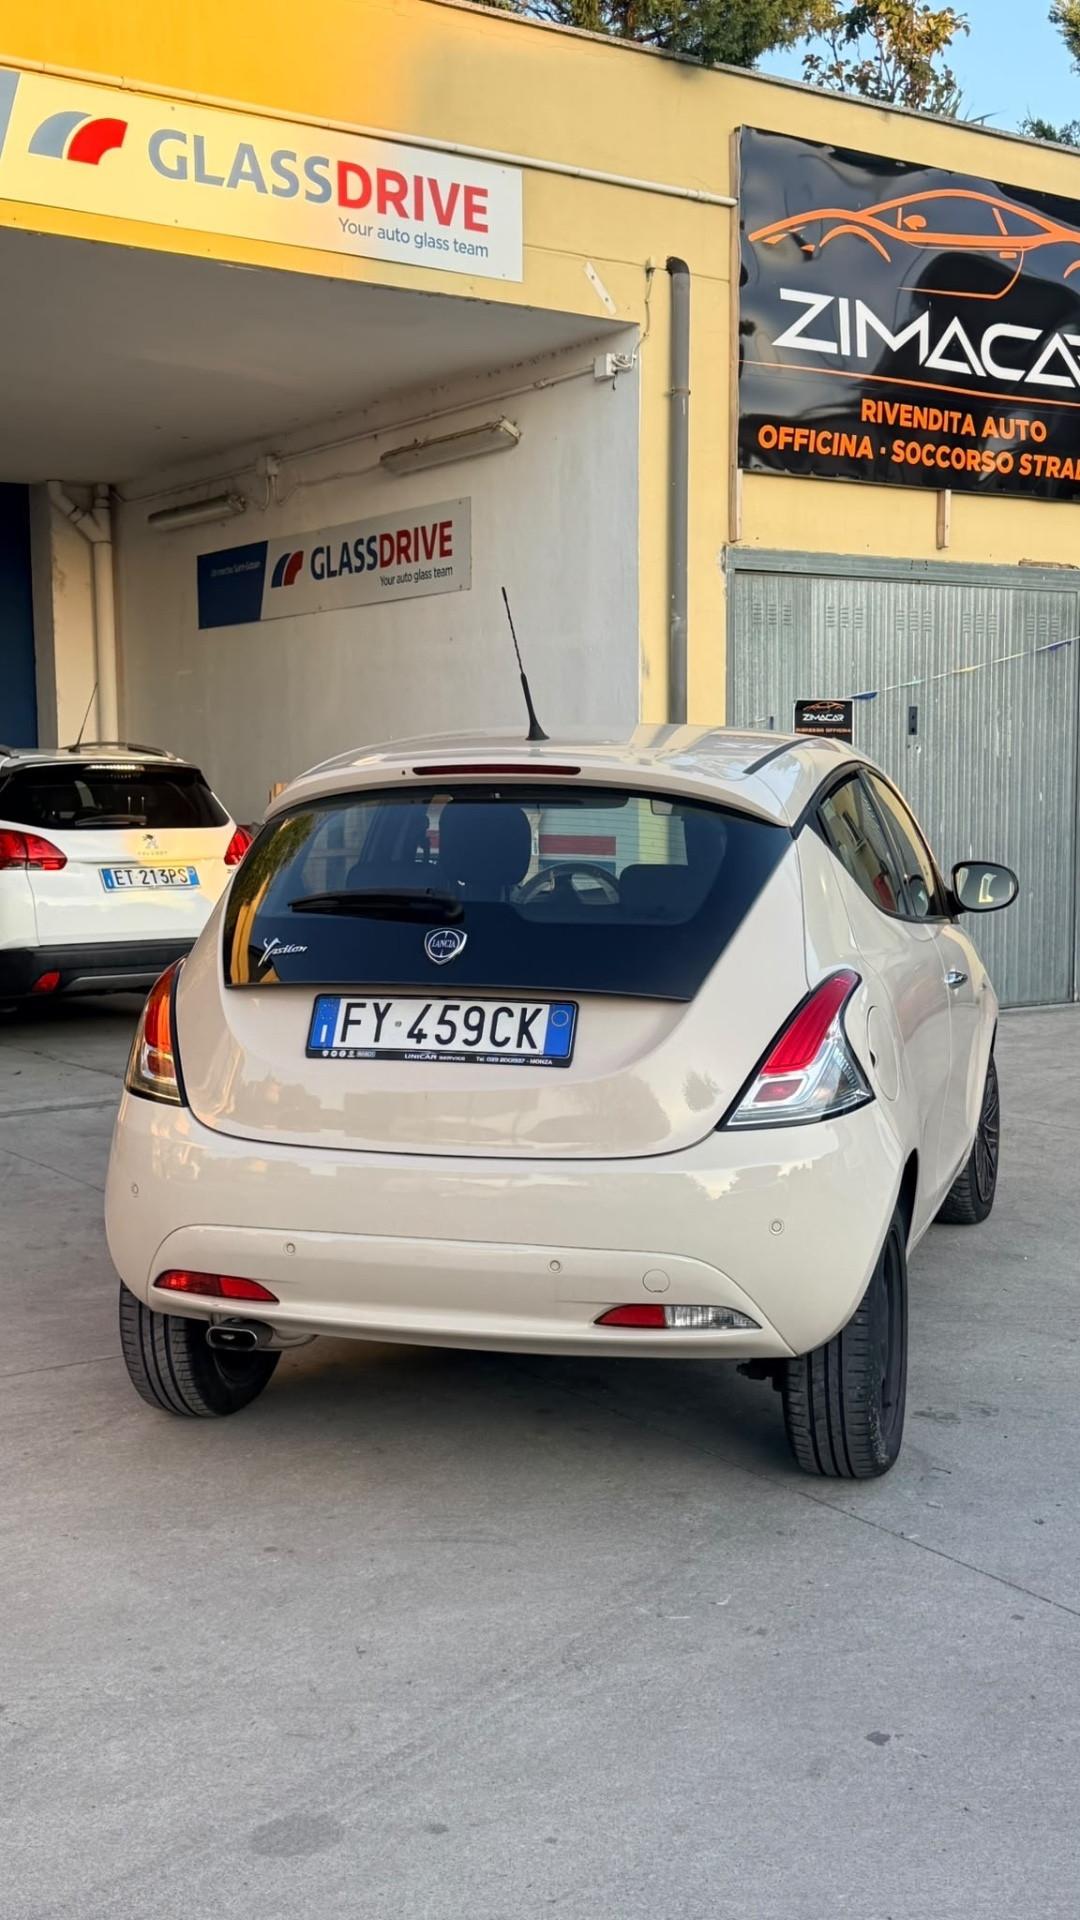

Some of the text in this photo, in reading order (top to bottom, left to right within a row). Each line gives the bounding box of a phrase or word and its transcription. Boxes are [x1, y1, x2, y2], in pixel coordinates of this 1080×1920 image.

[148, 128, 489, 234] GLASSDRIVE
[338, 217, 489, 258] Your auto glass team
[861, 399, 1047, 442] RIVENDITA AUTO
[757, 425, 873, 460] OFFICINA
[891, 440, 1014, 474] SOCCORSO
[310, 520, 453, 581] GLASSDRIVE
[379, 566, 453, 587] Your auto glass team
[802, 713, 845, 721] ZIMACAR
[114, 868, 188, 885] ET 213PS
[258, 937, 308, 967] Ypsilon
[431, 939, 456, 949] LANCIA
[340, 1002, 543, 1049] FY 459CK
